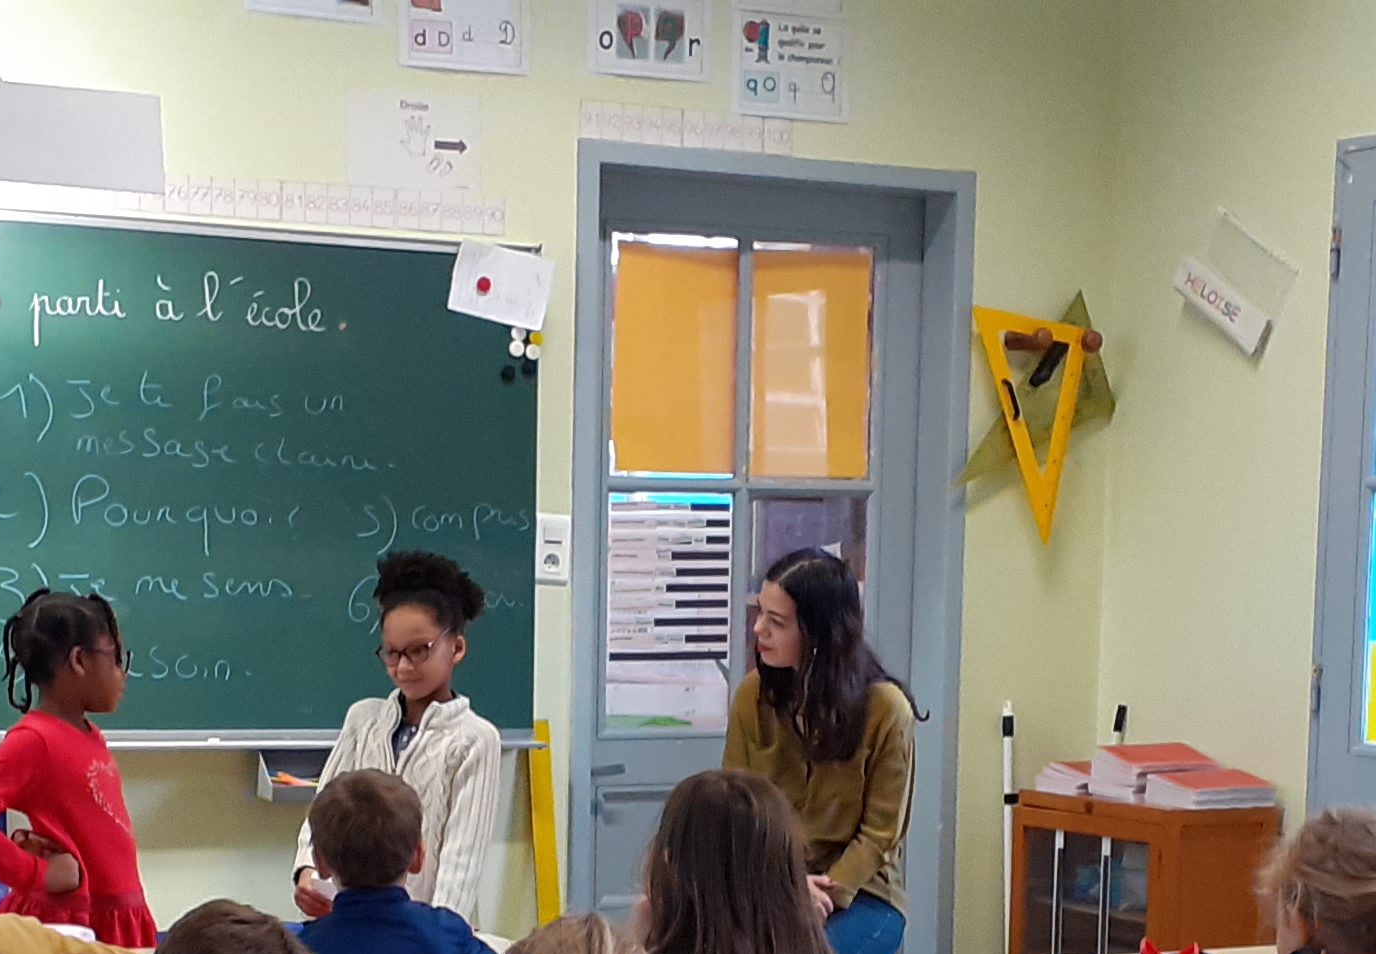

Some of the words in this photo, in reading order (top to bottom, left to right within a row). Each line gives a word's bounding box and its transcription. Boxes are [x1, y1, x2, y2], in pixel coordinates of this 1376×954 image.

[414, 28, 427, 47] d
[438, 31, 450, 48] D
[462, 24, 474, 43] d
[29, 279, 126, 347] parti
[155, 274, 184, 321] à
[67, 380, 119, 419] Je
[140, 370, 172, 407] te
[304, 394, 343, 414] un
[136, 575, 187, 601] me
